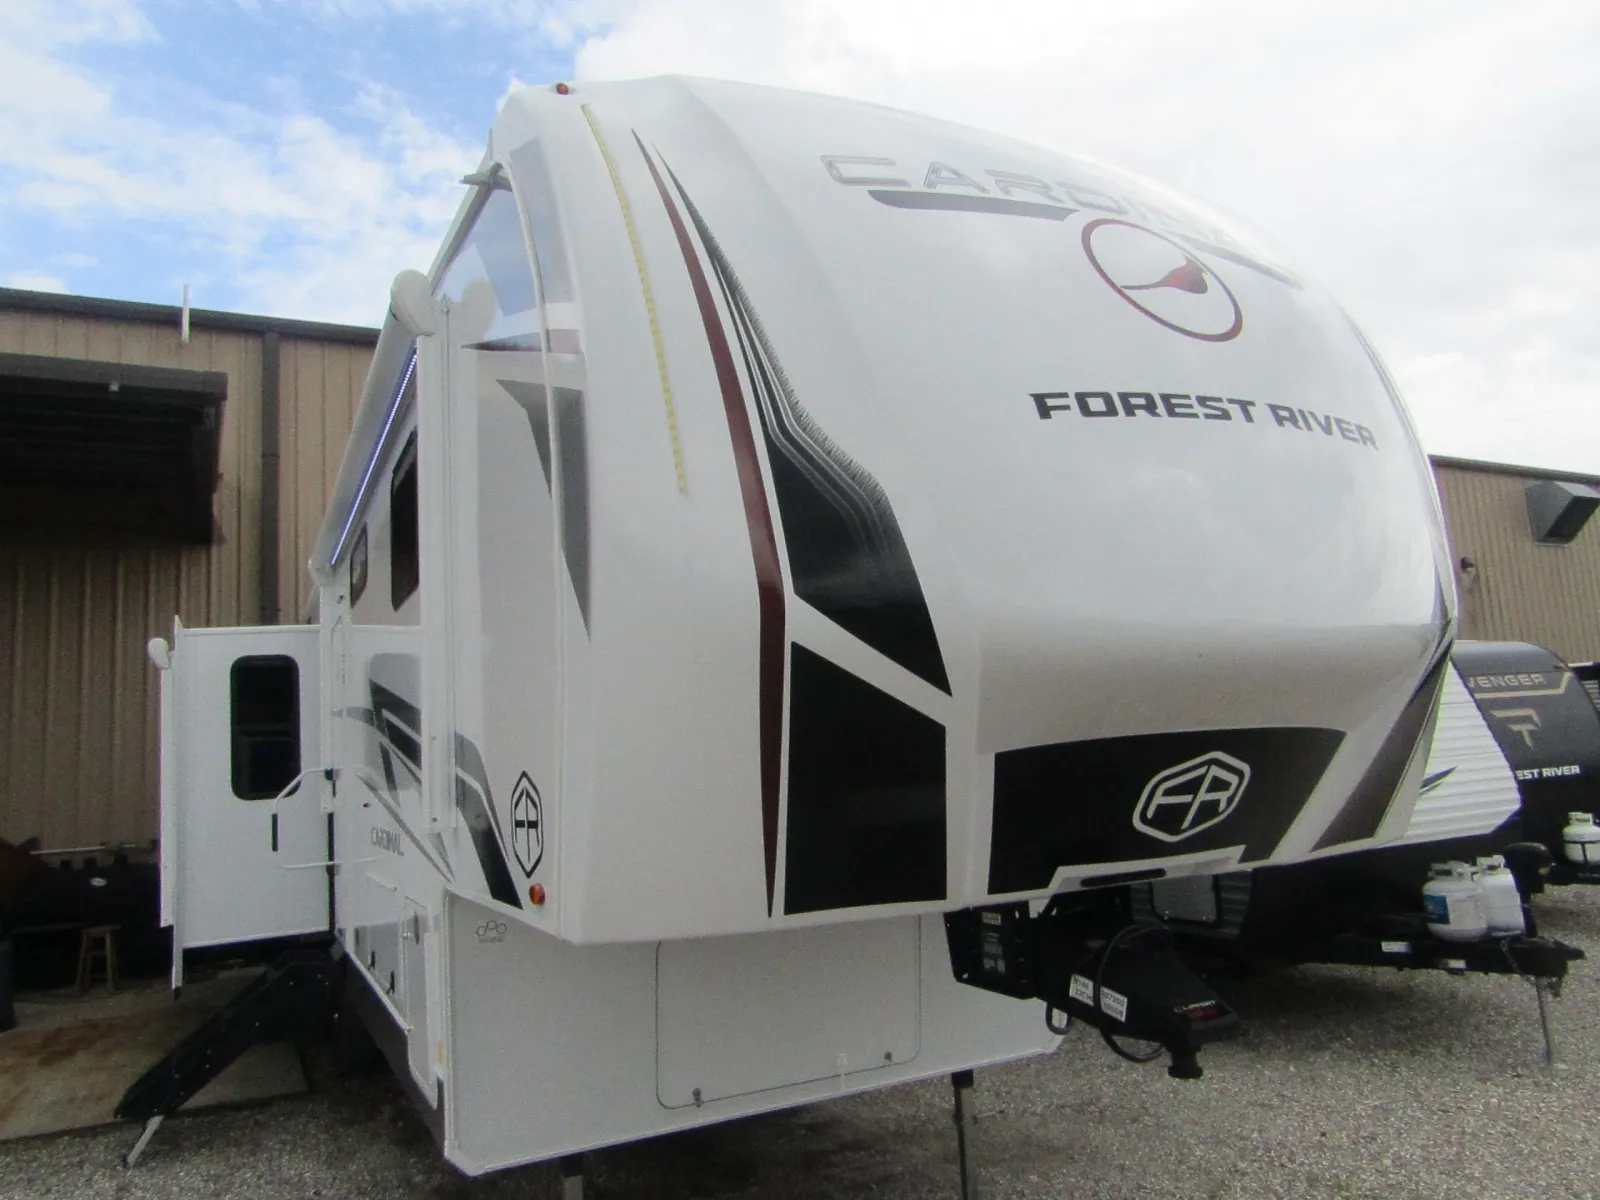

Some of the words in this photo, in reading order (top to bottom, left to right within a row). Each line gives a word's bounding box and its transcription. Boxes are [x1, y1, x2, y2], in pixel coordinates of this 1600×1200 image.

[1028, 391, 1256, 424] FOREST
[1267, 402, 1379, 451] RIVER
[1466, 673, 1546, 688] VENGER
[1515, 768, 1540, 780] EST
[1541, 765, 1580, 778] RIVER
